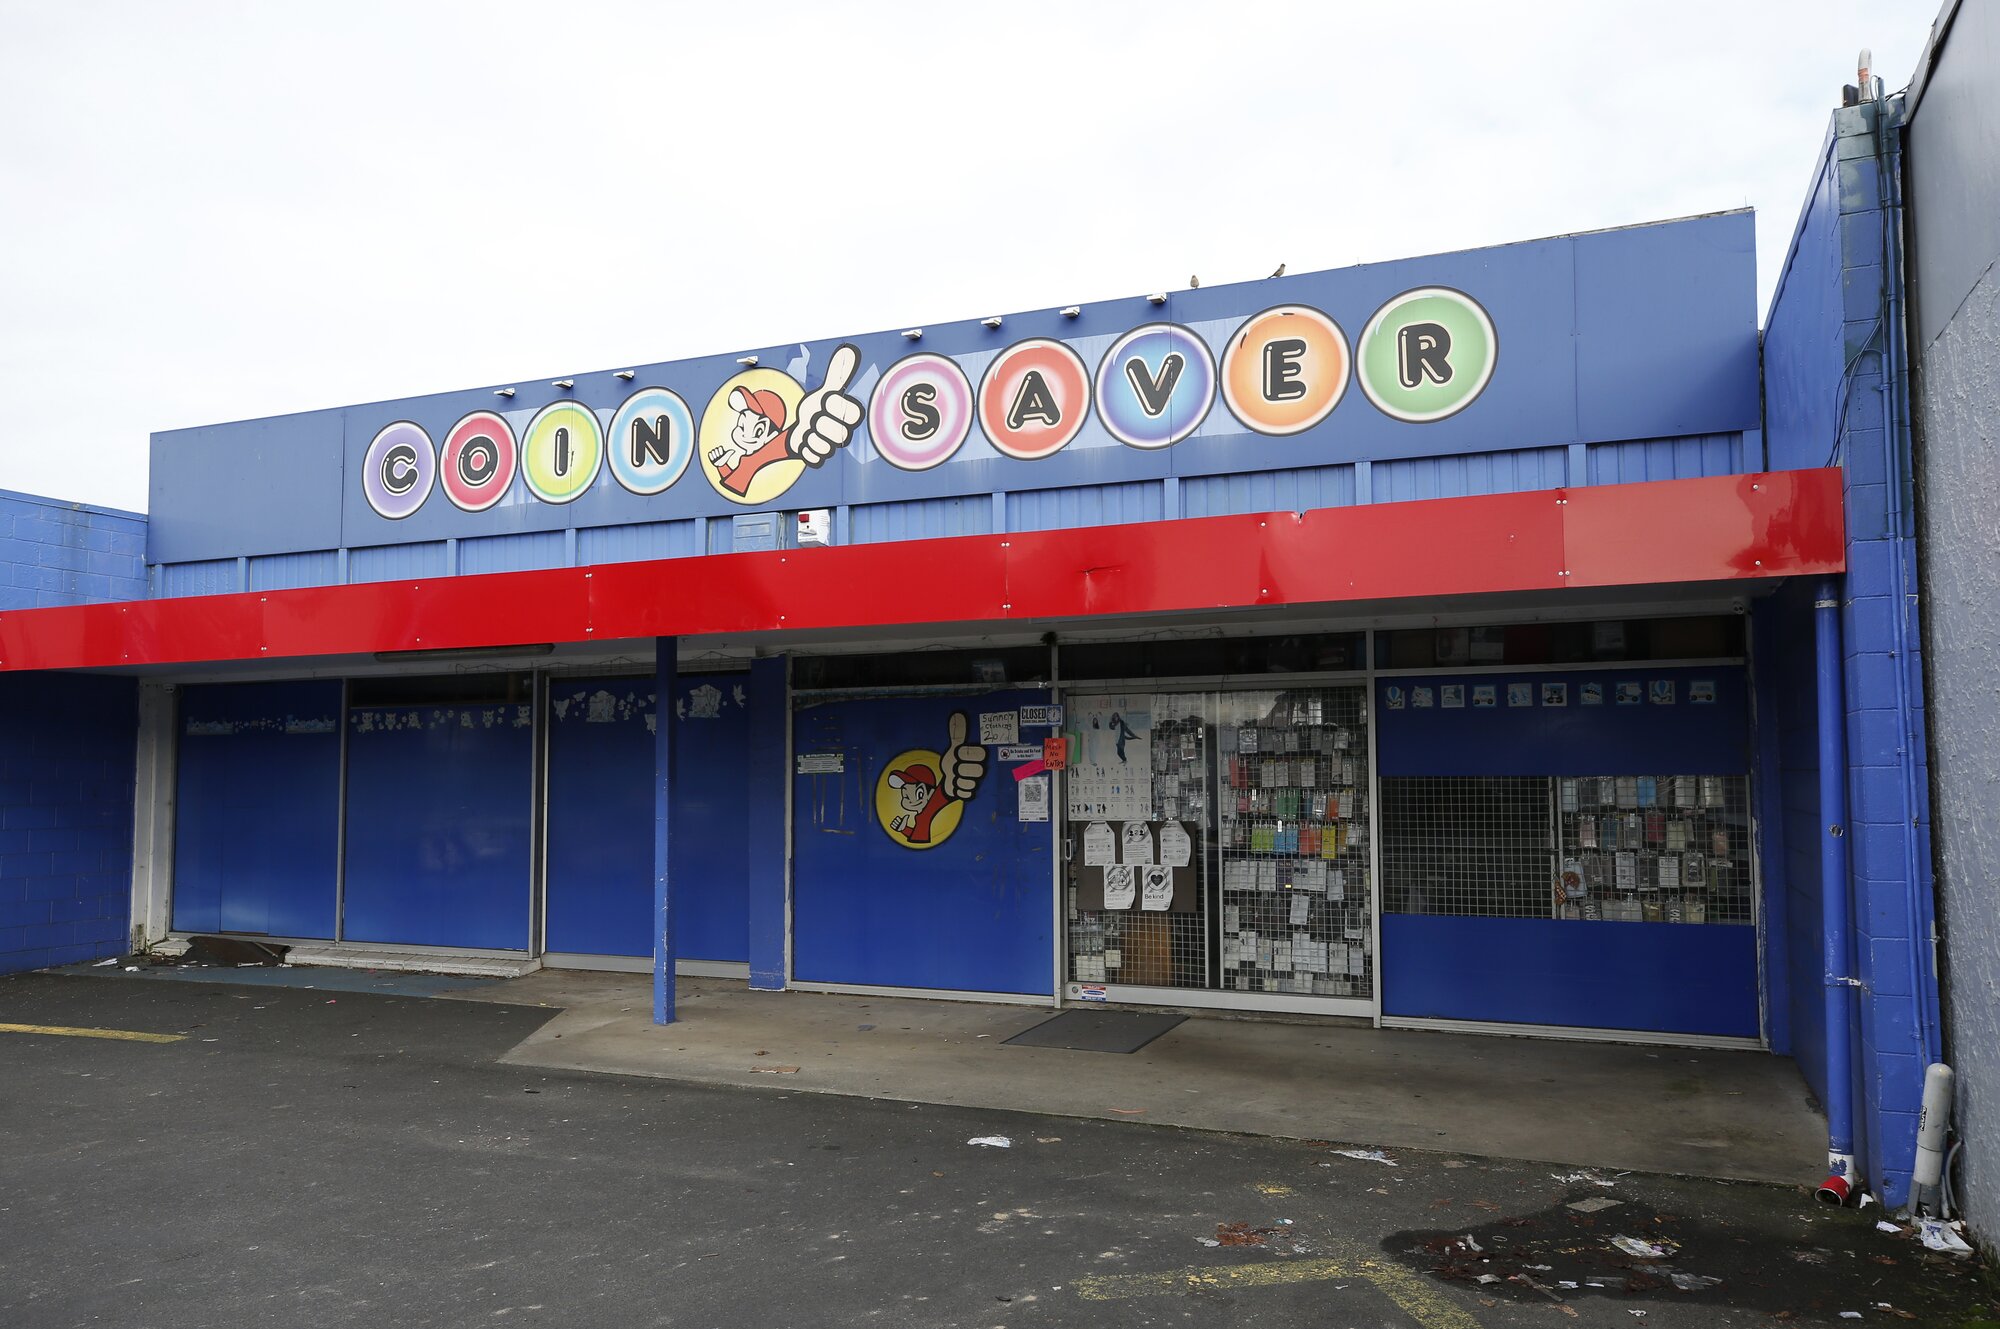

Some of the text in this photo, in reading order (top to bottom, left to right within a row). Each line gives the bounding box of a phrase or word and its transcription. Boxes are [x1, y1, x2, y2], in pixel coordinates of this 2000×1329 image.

[380, 321, 1456, 495] COIN SAVER
[1022, 708, 1046, 719] CLOSED
